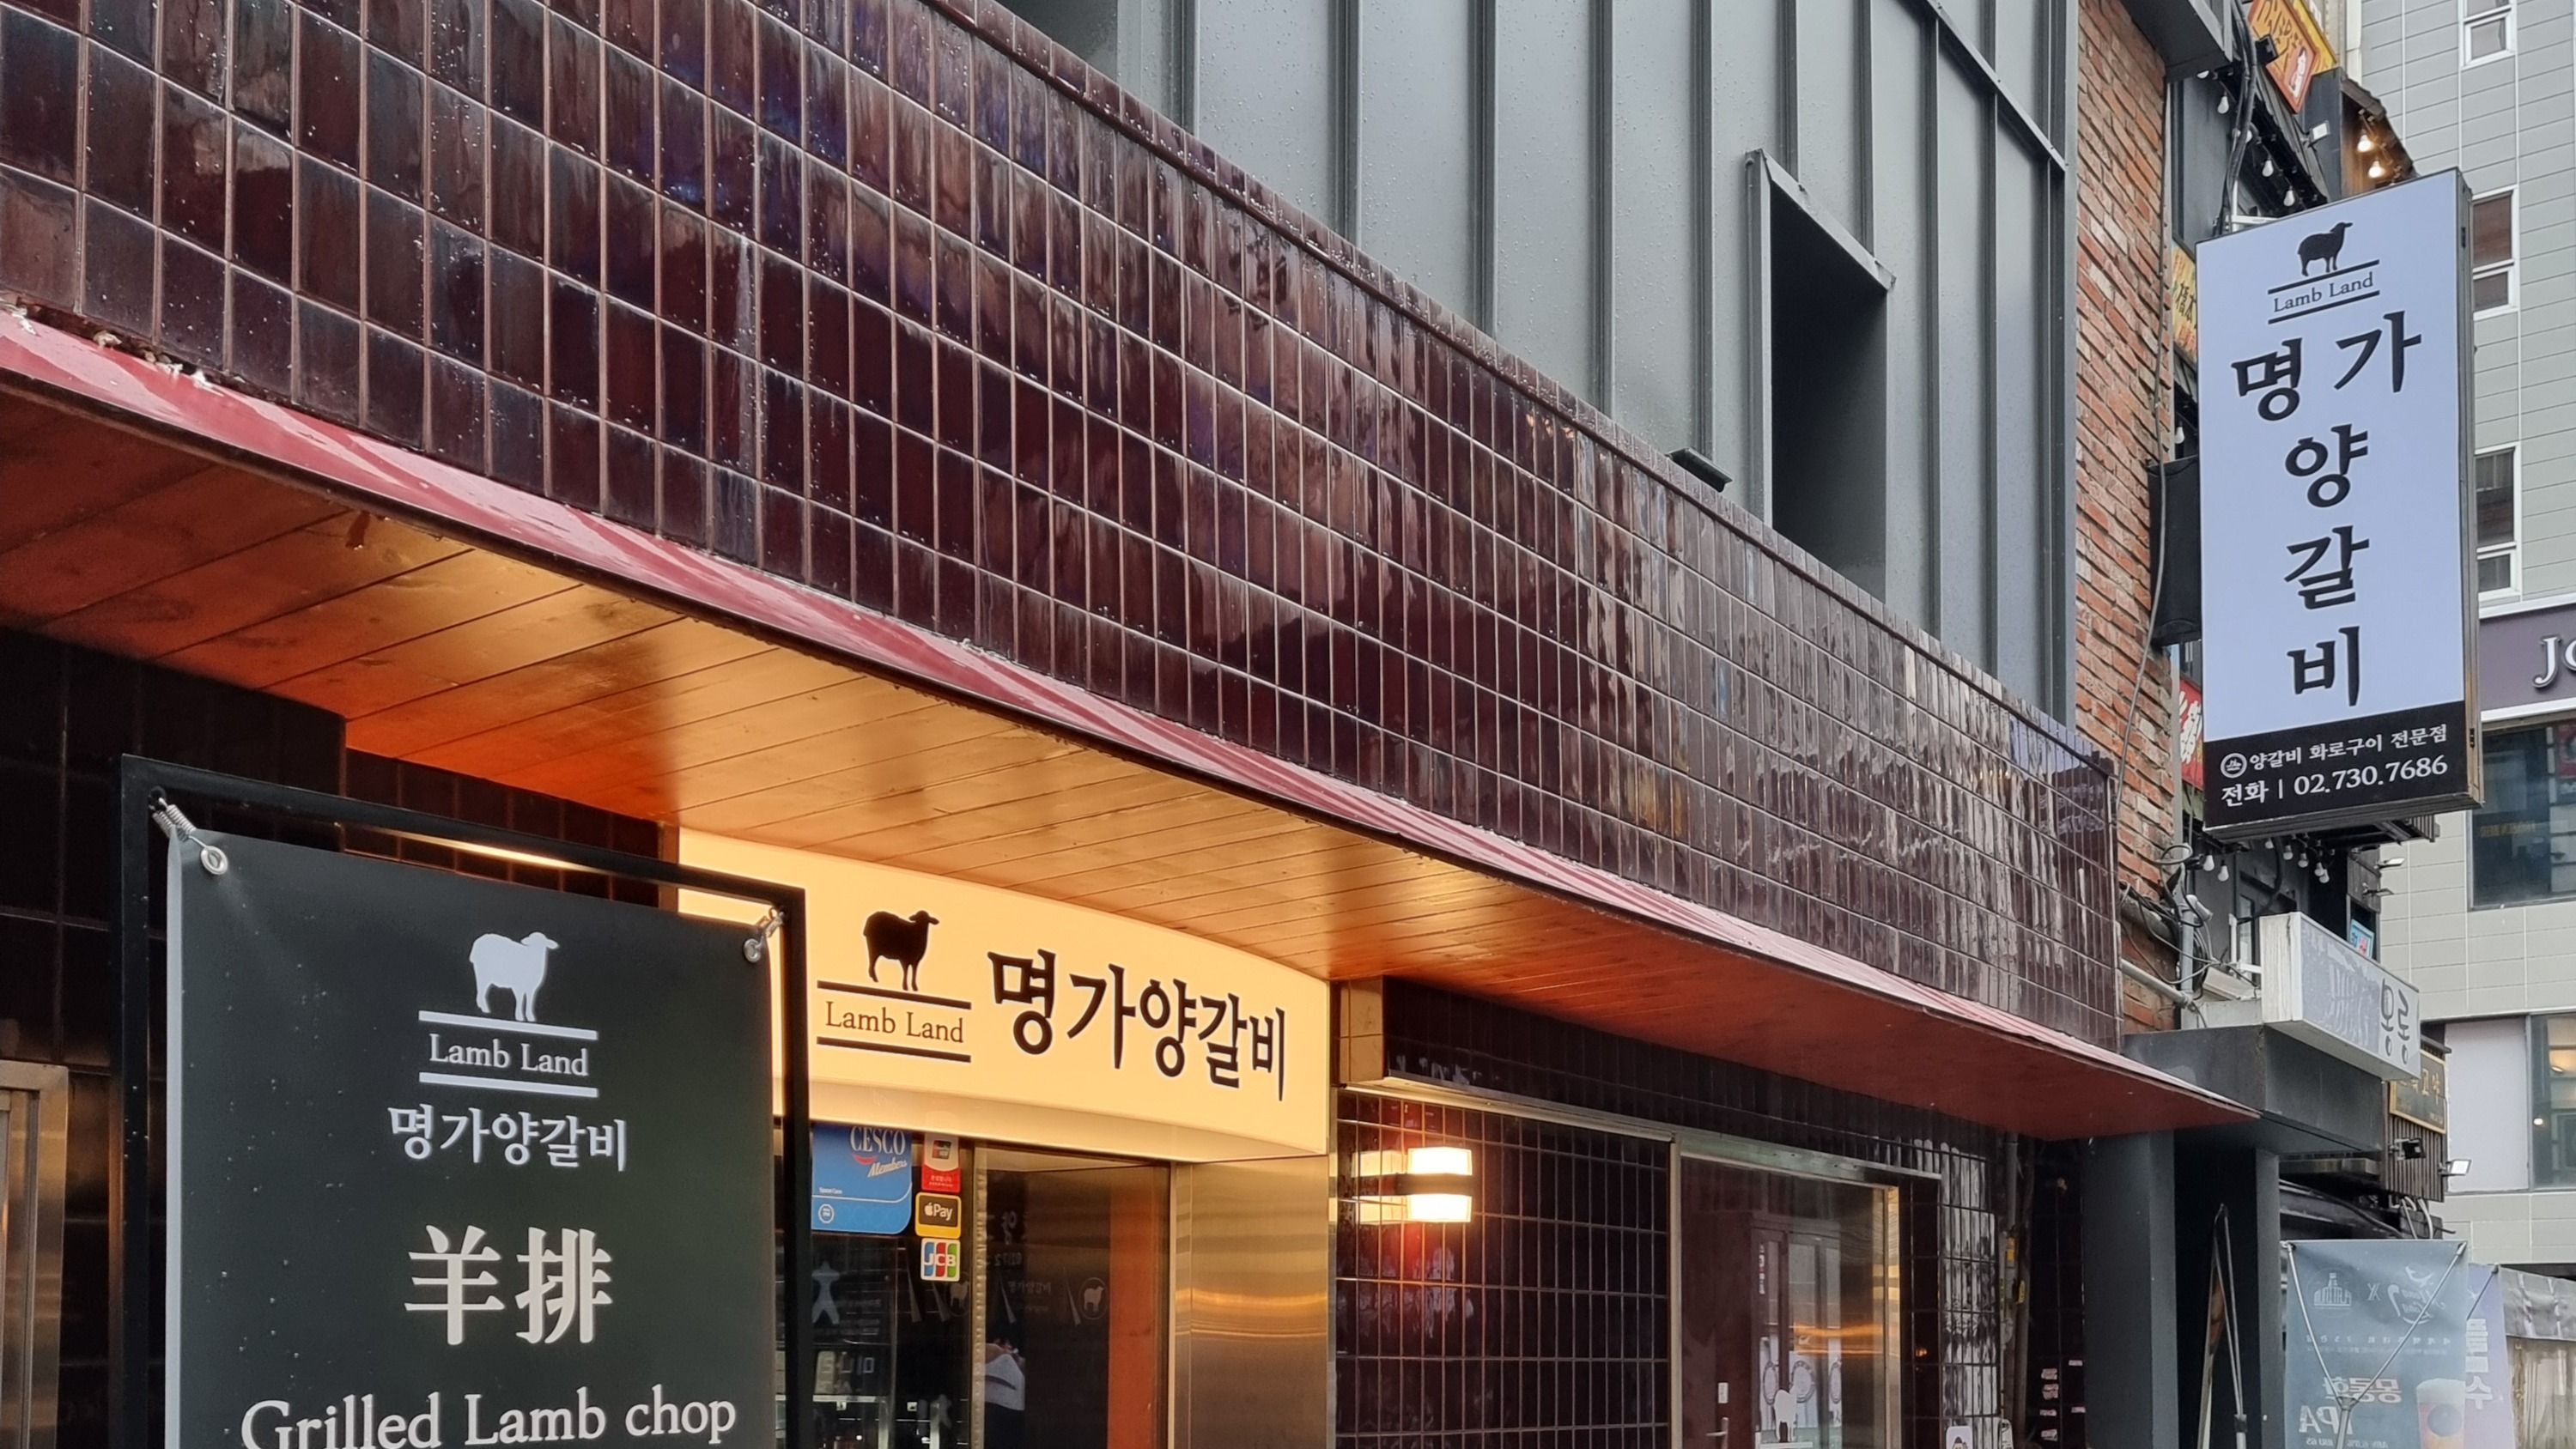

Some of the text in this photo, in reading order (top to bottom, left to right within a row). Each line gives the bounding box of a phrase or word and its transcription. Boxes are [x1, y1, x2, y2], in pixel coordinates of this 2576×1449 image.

[2274, 271, 2373, 312] Lamb Land
[2231, 311, 2422, 421] 명가
[2249, 724, 2448, 771] 양갈비 화로구이 전문점
[2221, 755, 2448, 807] 전화 02.730.7686
[825, 1001, 964, 1043] Lamb Land
[987, 949, 1285, 1101] 명가양갈비
[429, 1033, 589, 1076] Lamb Land
[387, 1103, 627, 1172] 명가양갈비
[850, 1125, 906, 1155] CESCO
[867, 1157, 908, 1178] Members
[933, 1203, 953, 1221] Pay
[924, 1254, 957, 1267] JCB
[404, 1225, 613, 1346] 羊排
[241, 1385, 736, 1449] Grilled Lamb chop
